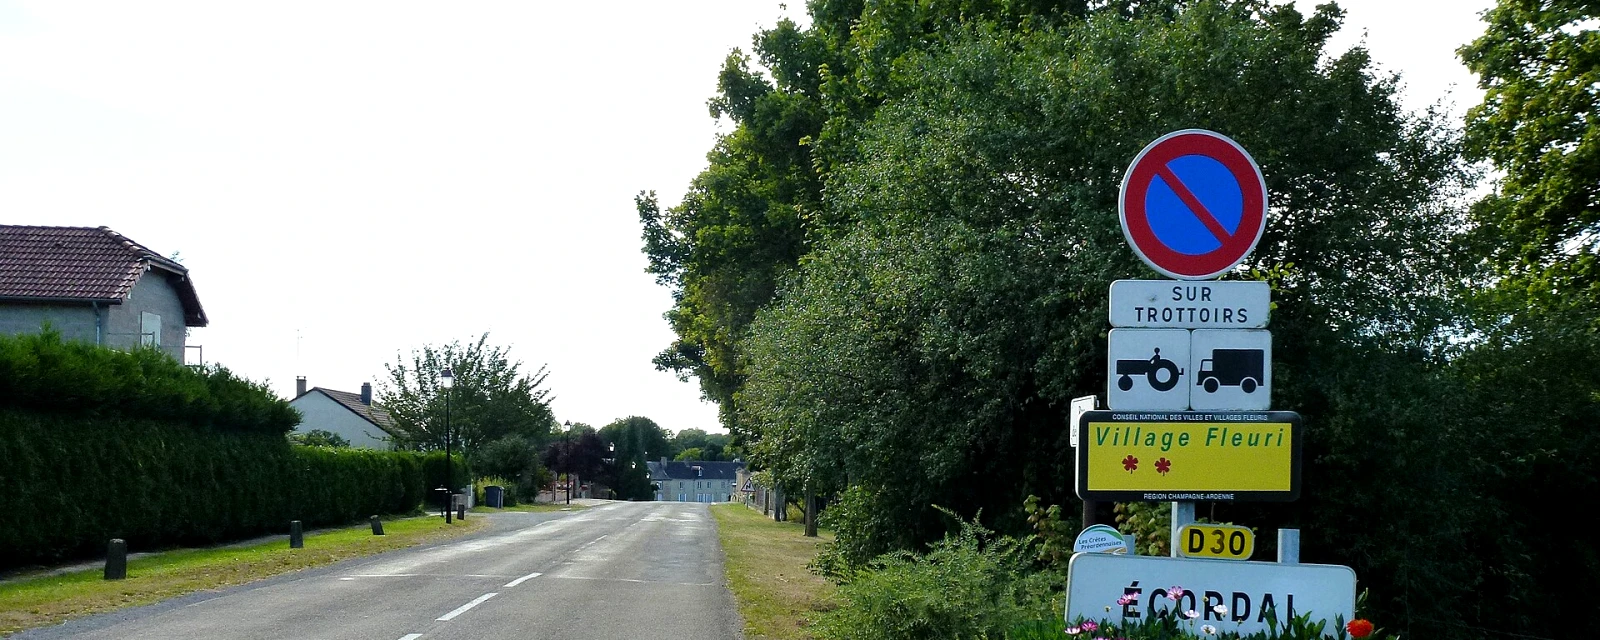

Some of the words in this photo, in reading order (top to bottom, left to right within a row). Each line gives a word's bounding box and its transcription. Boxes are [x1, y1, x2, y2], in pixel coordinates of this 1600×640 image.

[1172, 286, 1212, 302] SUR
[1135, 307, 1248, 323] TROTTOIRS
[1096, 426, 1190, 452] Village
[1205, 427, 1284, 447] Fleuri
